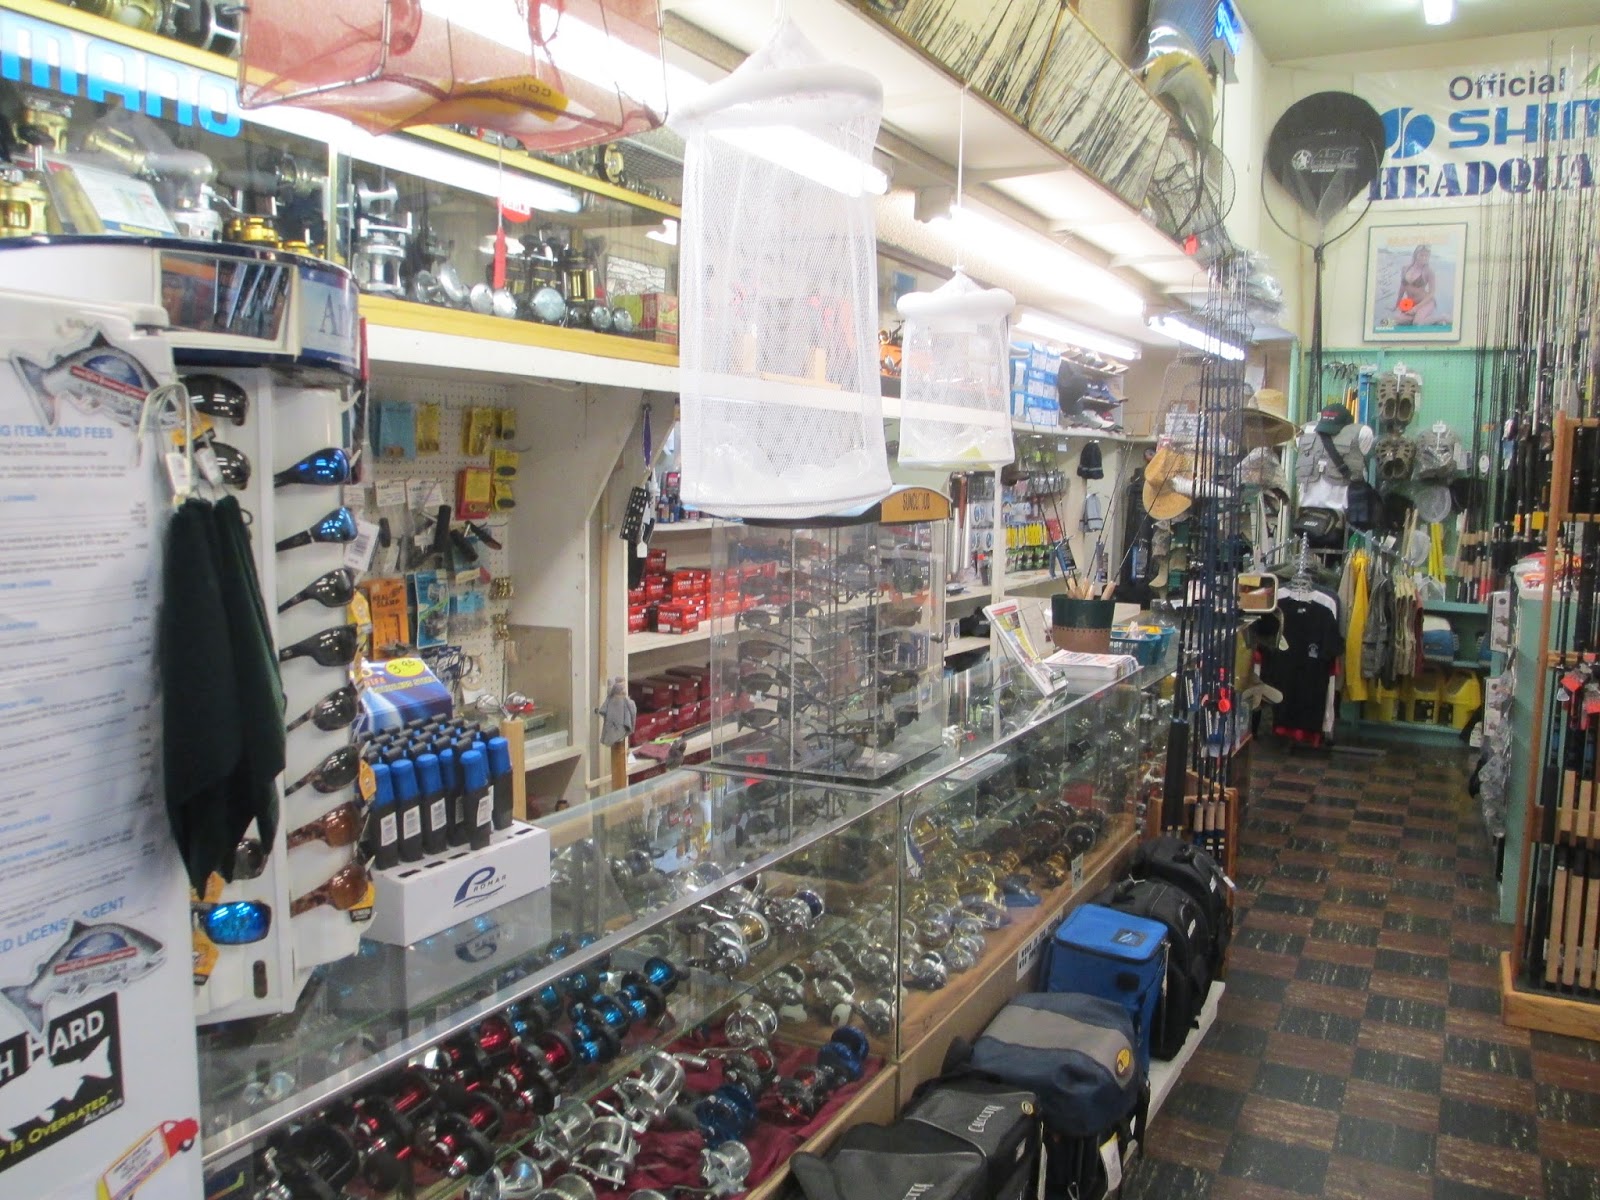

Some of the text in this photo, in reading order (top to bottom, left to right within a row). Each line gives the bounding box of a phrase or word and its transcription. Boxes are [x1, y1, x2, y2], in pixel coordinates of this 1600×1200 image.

[1449, 67, 1565, 101] Official
[15, 424, 53, 437] ITEM
[56, 427, 81, 438] AND
[84, 427, 113, 439] FEES
[18, 917, 74, 947] LICENS
[26, 1010, 104, 1067] HARD
